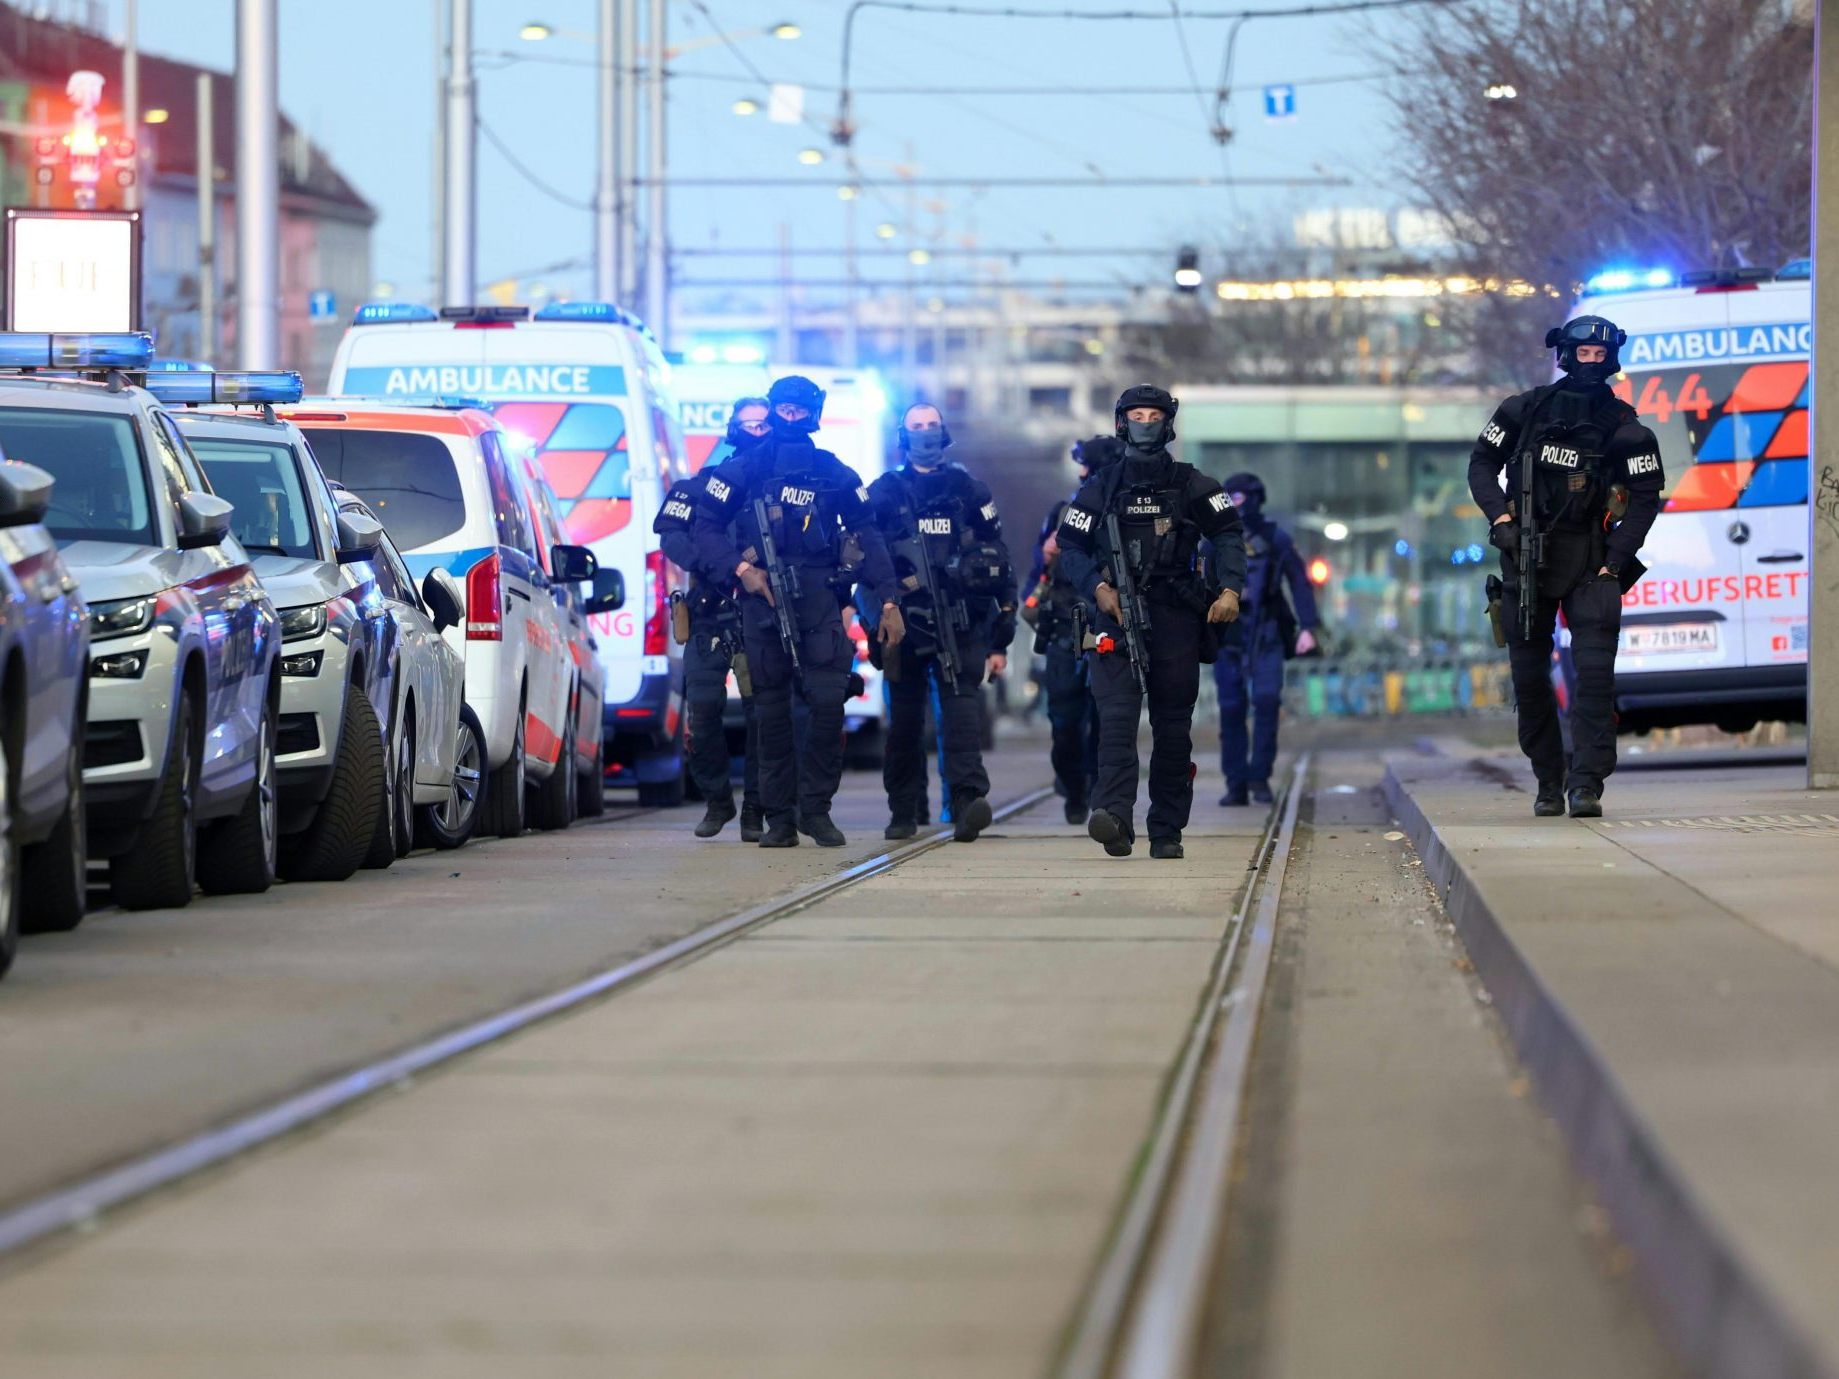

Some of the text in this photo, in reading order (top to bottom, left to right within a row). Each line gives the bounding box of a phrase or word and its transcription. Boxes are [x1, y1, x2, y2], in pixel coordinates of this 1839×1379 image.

[384, 366, 591, 395] AMBULANCE
[1482, 421, 1506, 447] EGA
[1540, 444, 1579, 468] POLIZEI
[1627, 453, 1660, 475] WEGA
[780, 486, 816, 506] POLIZEI
[662, 500, 692, 520] WEGA
[1064, 507, 1093, 533] WEGA
[1127, 506, 1161, 514] POLIZEI
[918, 518, 952, 535] POLIZEI
